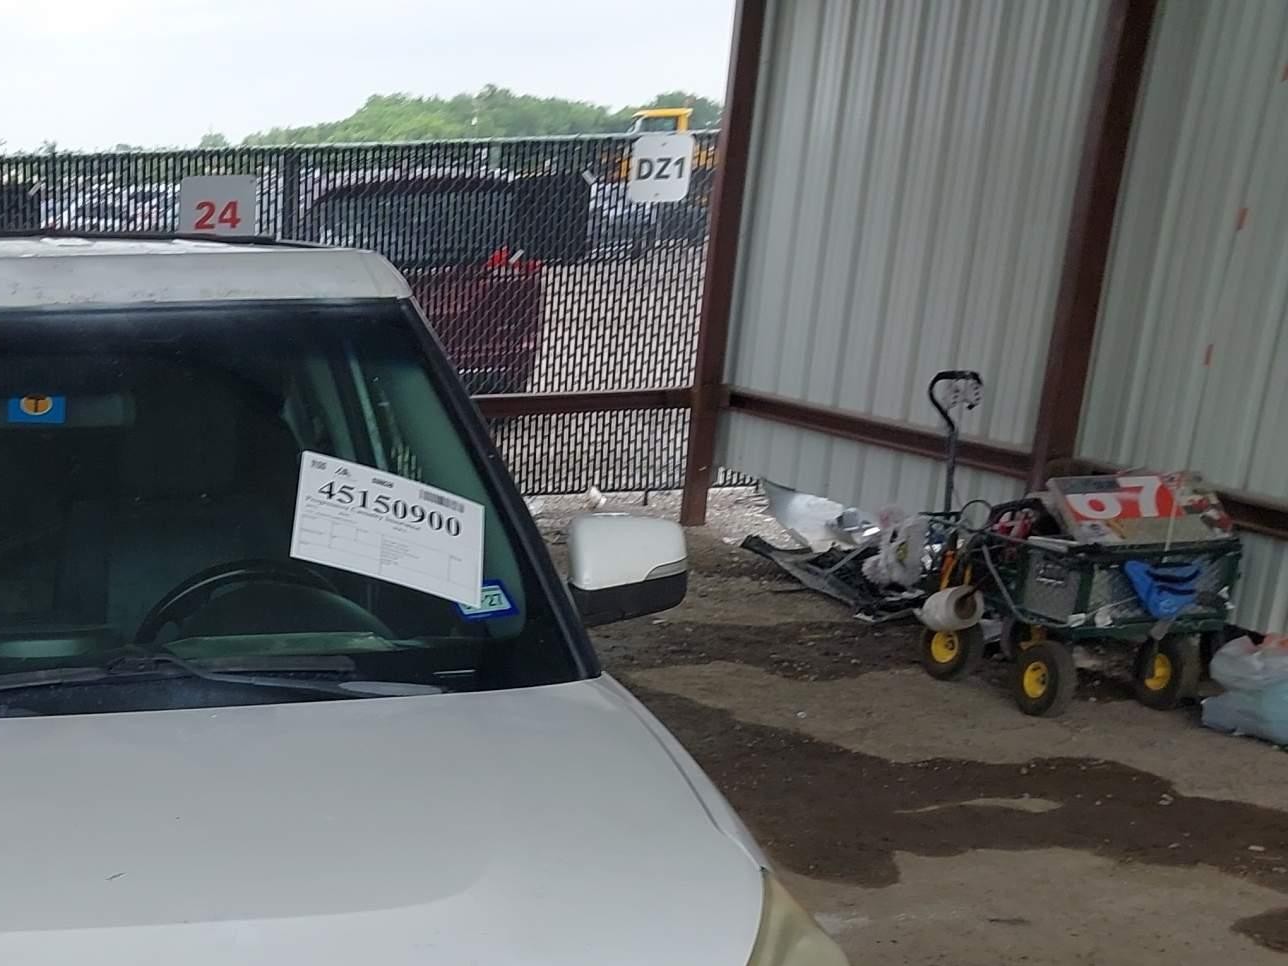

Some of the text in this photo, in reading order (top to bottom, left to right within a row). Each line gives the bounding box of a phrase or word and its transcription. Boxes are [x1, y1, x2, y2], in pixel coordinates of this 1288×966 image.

[637, 156, 685, 180] DZ1
[195, 200, 240, 230] 24
[318, 480, 461, 537] 45150900
